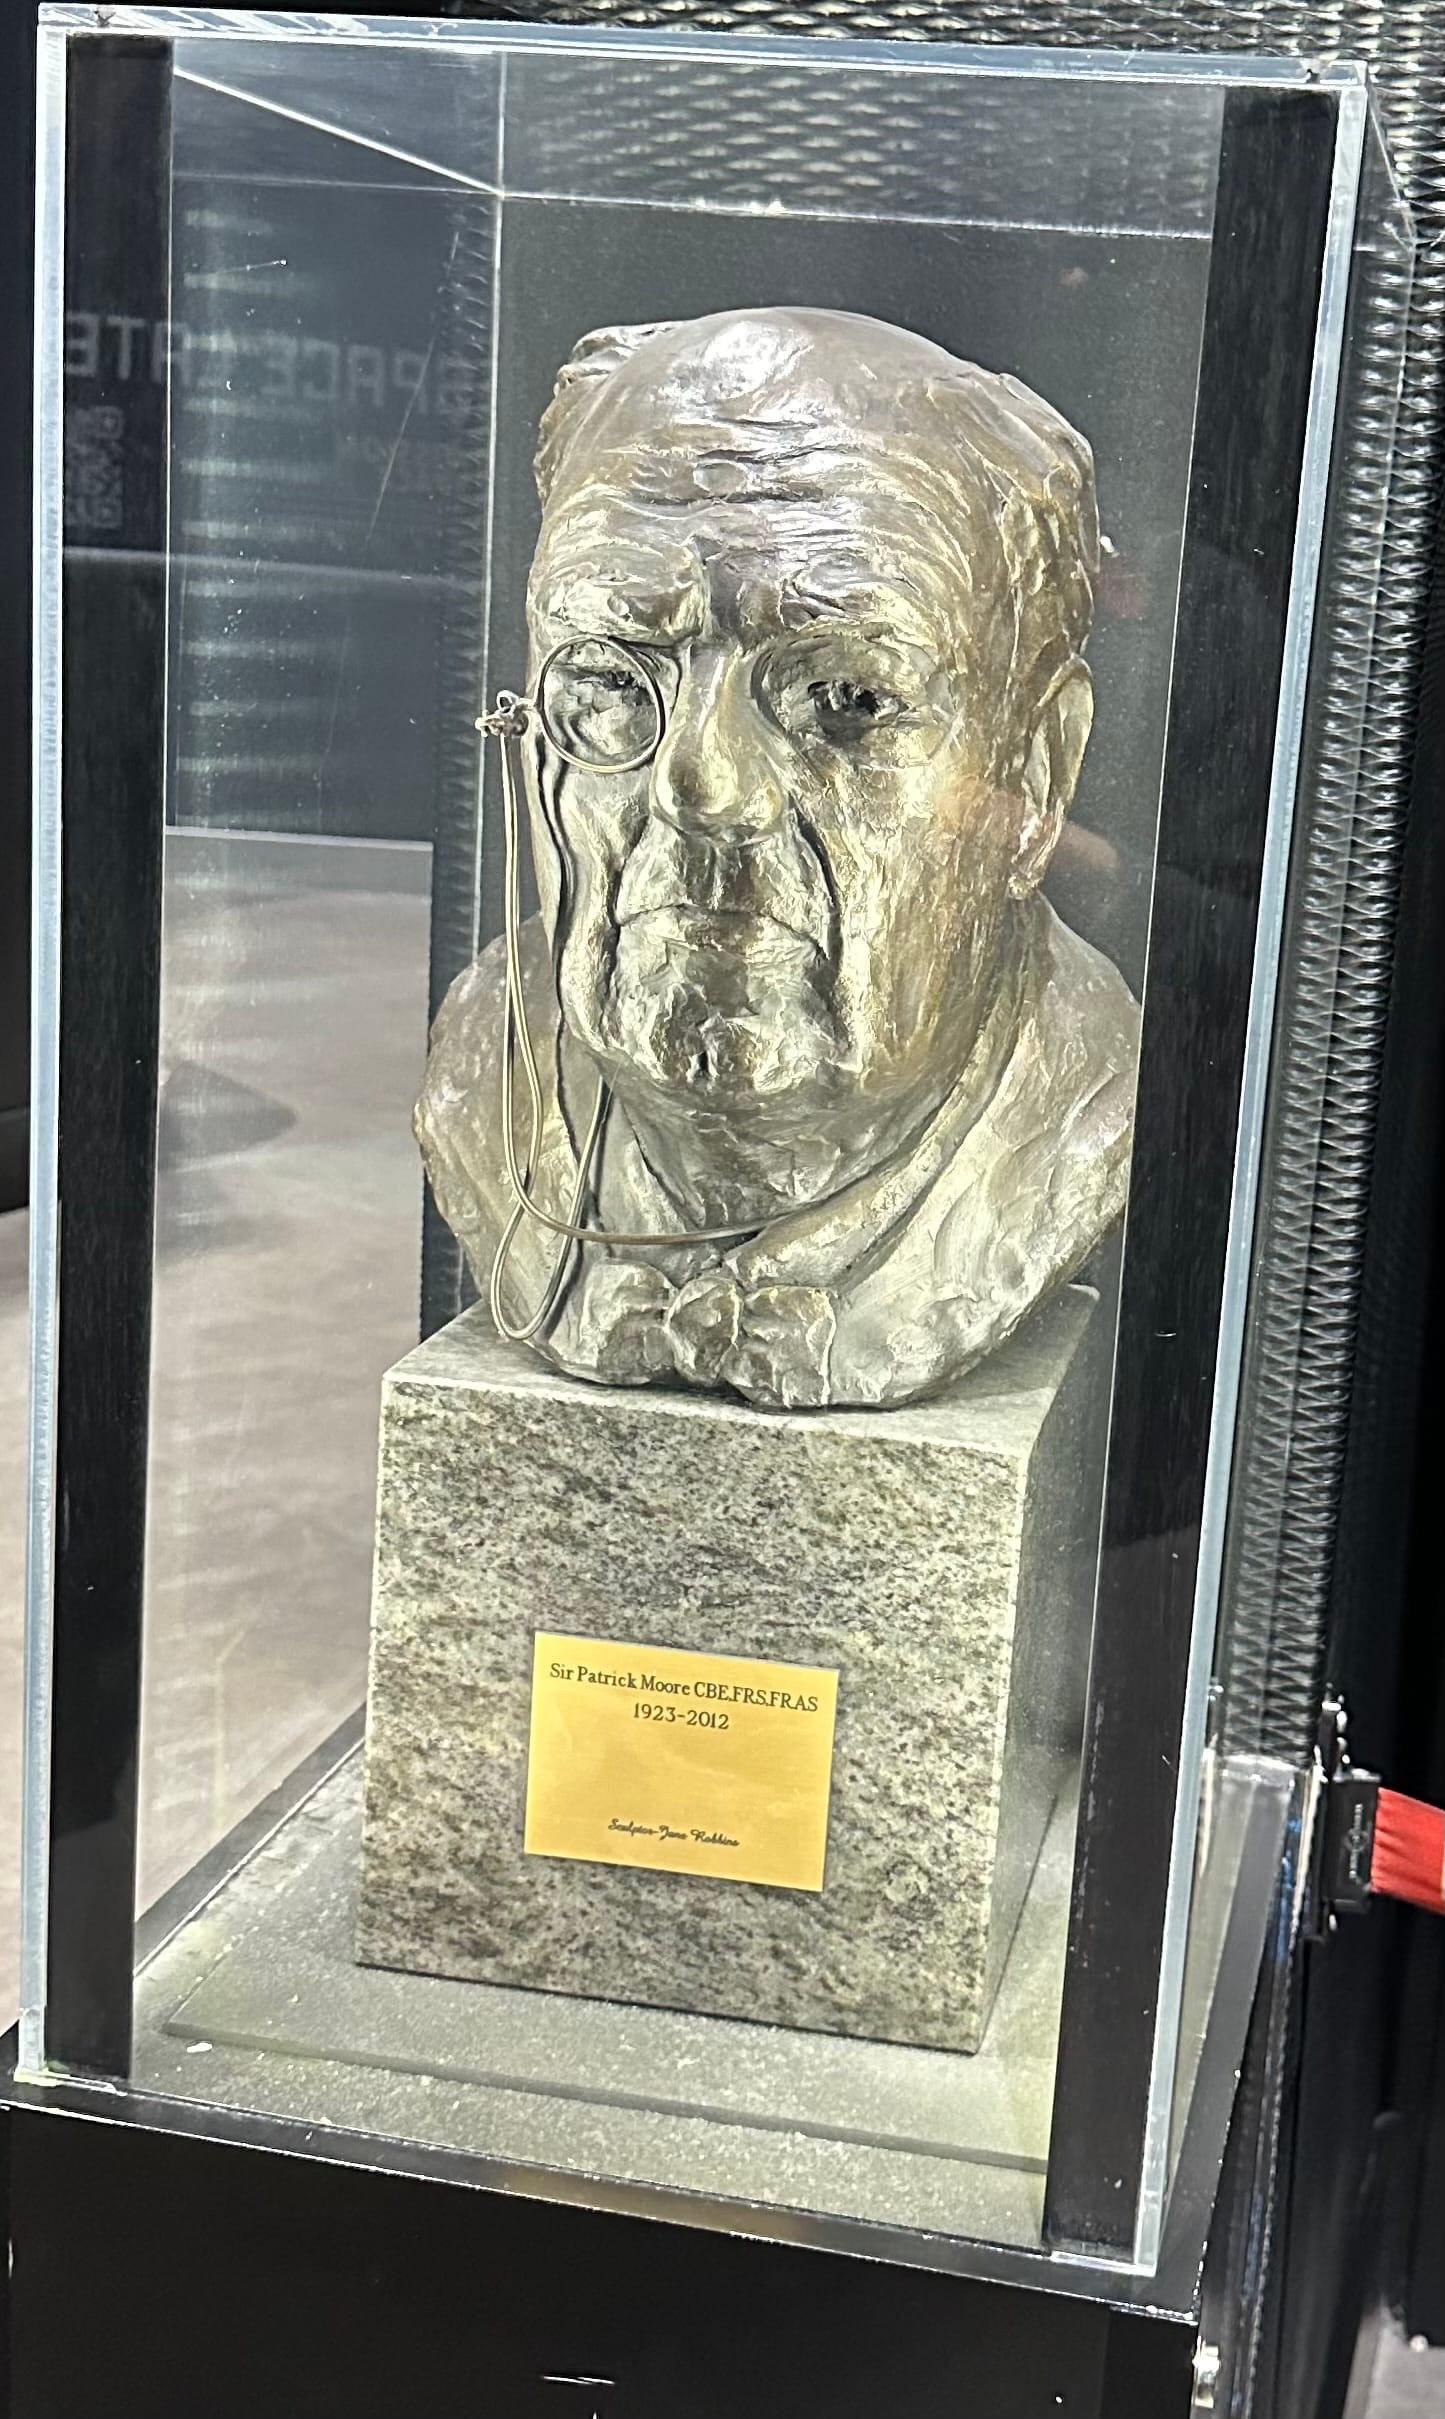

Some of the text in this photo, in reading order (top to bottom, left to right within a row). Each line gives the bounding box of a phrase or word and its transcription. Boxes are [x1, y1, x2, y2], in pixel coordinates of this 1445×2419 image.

[549, 1662, 575, 1681] Sir
[576, 1665, 637, 1690] Patrick
[640, 1673, 691, 1696] Moore
[633, 1702, 730, 1730] 1923-2012
[689, 1828, 740, 1847] Robbins
